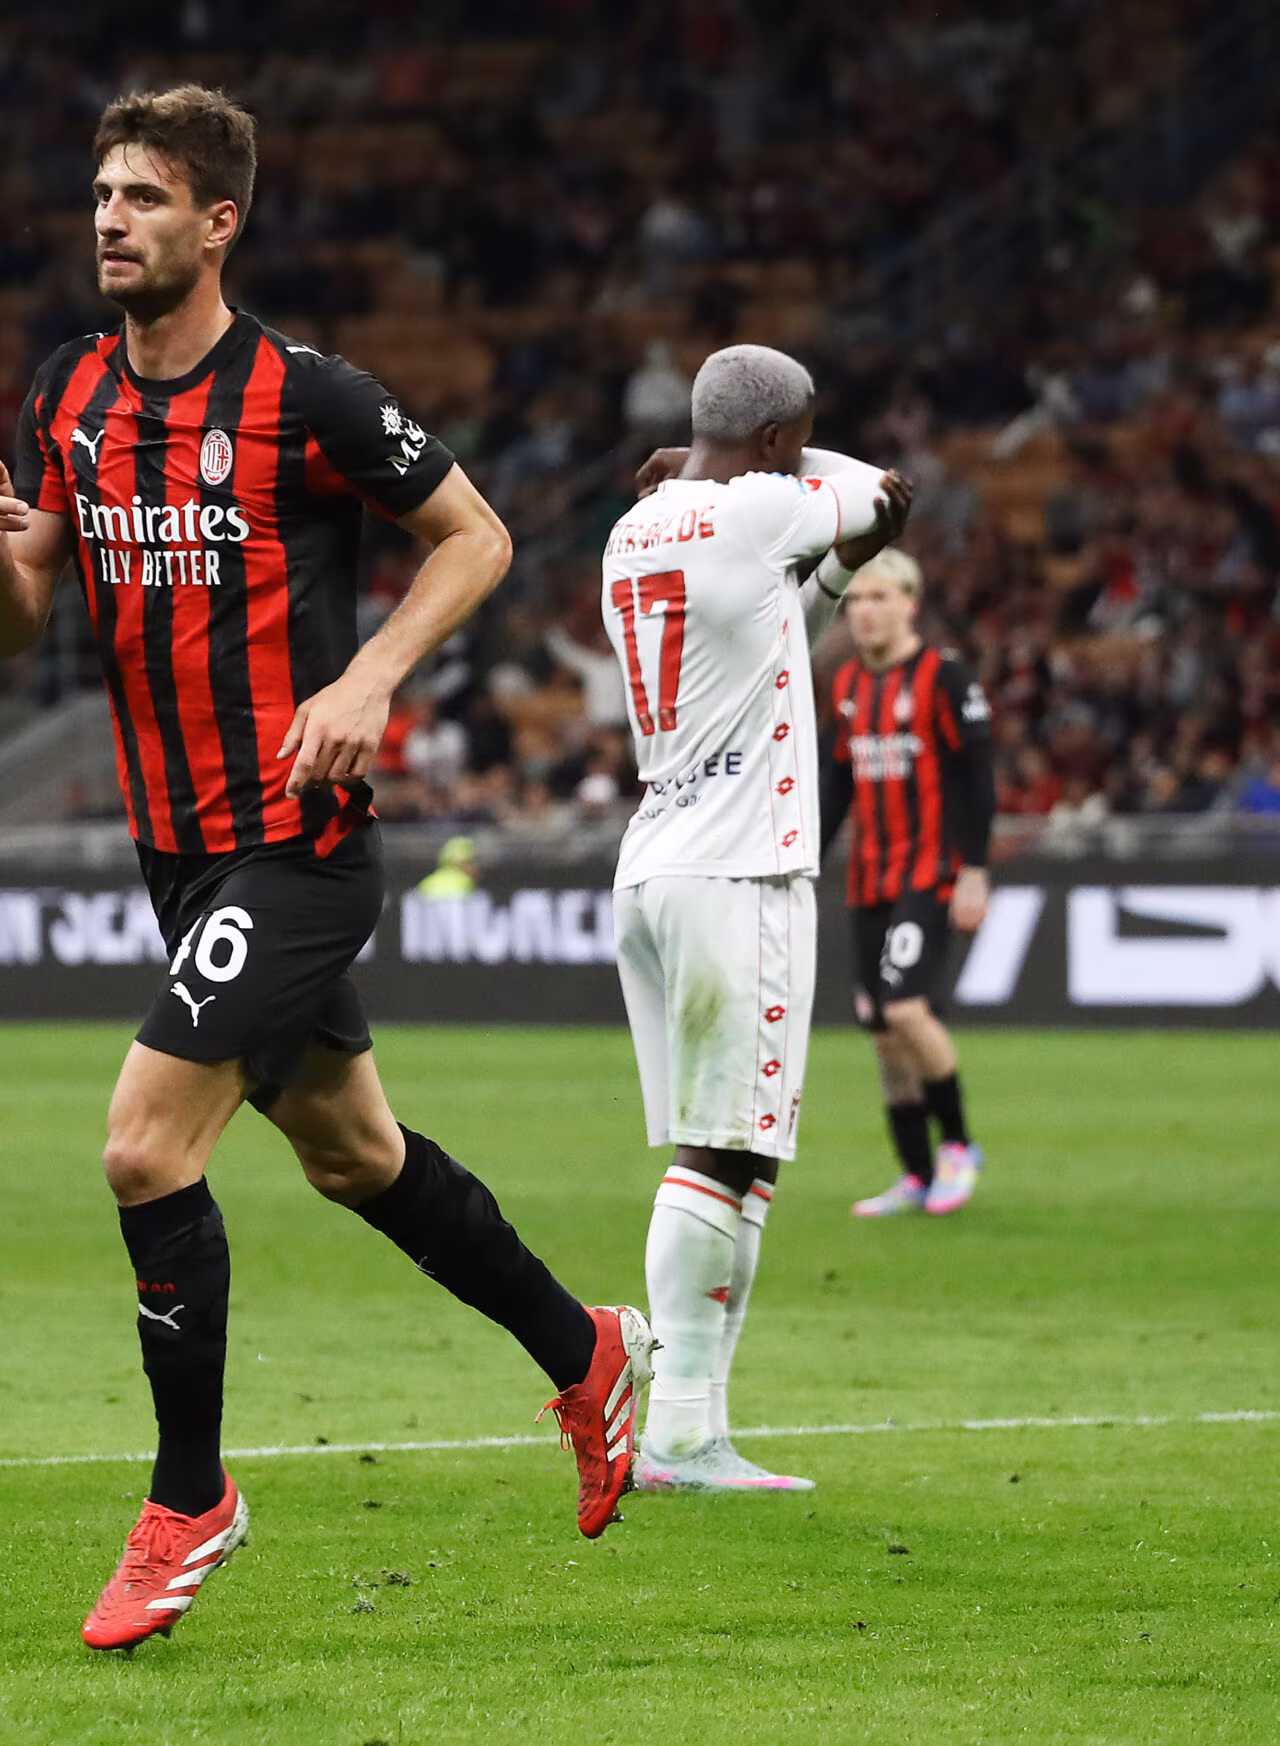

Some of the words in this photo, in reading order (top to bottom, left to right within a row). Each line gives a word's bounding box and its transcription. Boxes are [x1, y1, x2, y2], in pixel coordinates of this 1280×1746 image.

[74, 493, 251, 543] Emirates
[99, 547, 131, 584] FLY
[141, 549, 222, 588] BETTER
[611, 569, 686, 736] 17
[883, 920, 925, 968] 0
[954, 885, 1280, 1005] AS
